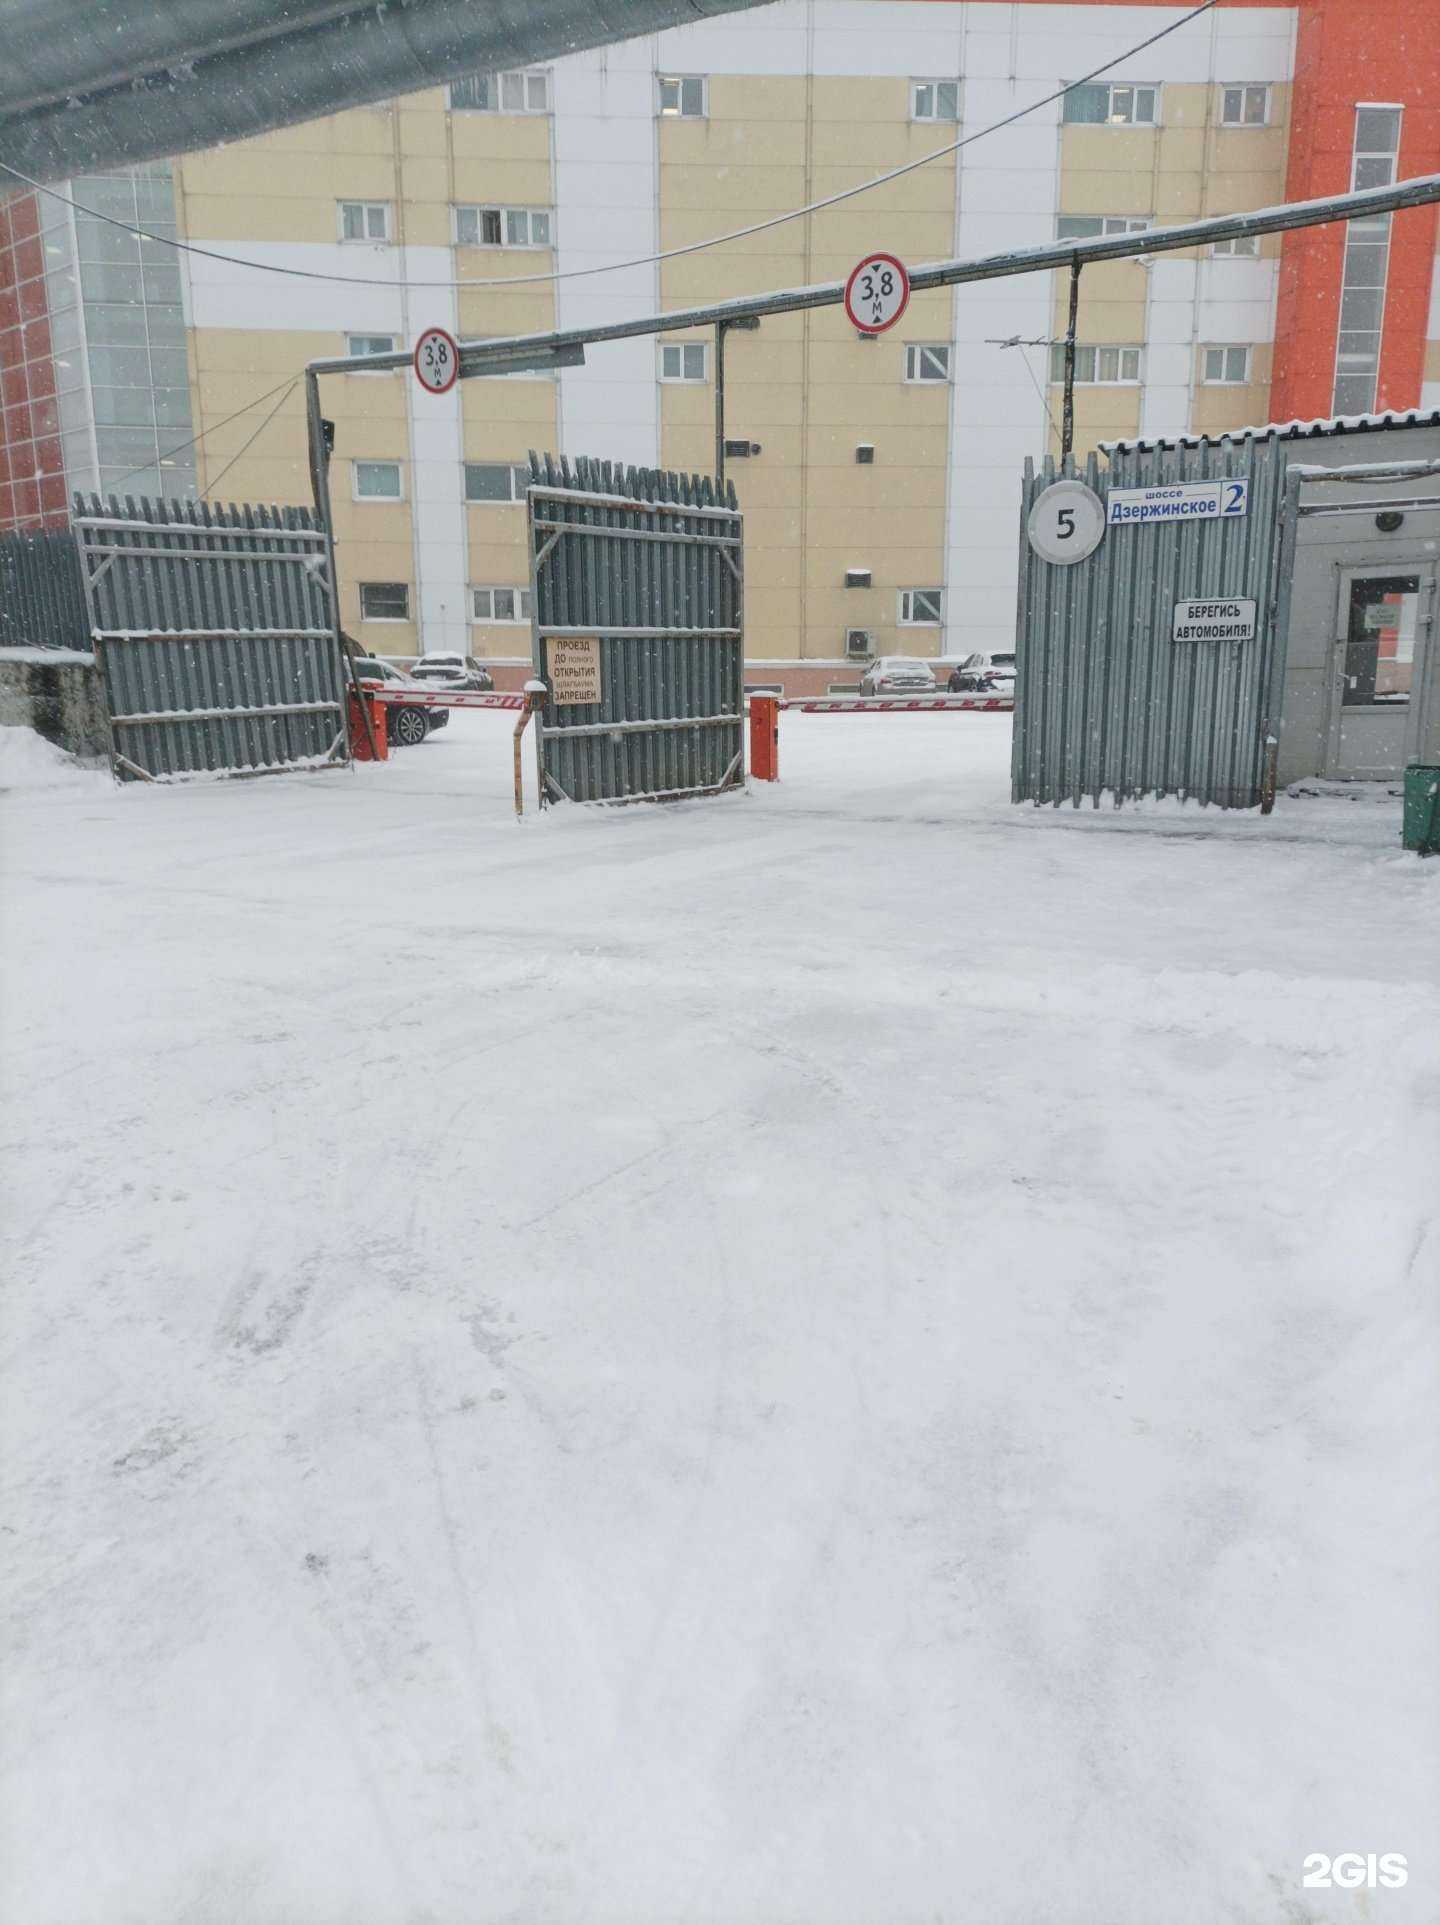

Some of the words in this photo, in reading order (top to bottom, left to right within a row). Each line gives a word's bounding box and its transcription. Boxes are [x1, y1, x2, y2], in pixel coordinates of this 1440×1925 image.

[861, 271, 893, 301] 3,8
[1111, 500, 1217, 521] Дзержинское
[1224, 484, 1244, 513] 2
[1056, 508, 1075, 539] 5
[1188, 605, 1241, 618] БЕРЕГИСЬ
[1176, 624, 1251, 638] АВТОМОБИЛЯ!
[557, 641, 590, 652] ПРОЕЗД
[554, 654, 567, 664] ДО
[554, 667, 596, 677] ОТКРЫТИЯ
